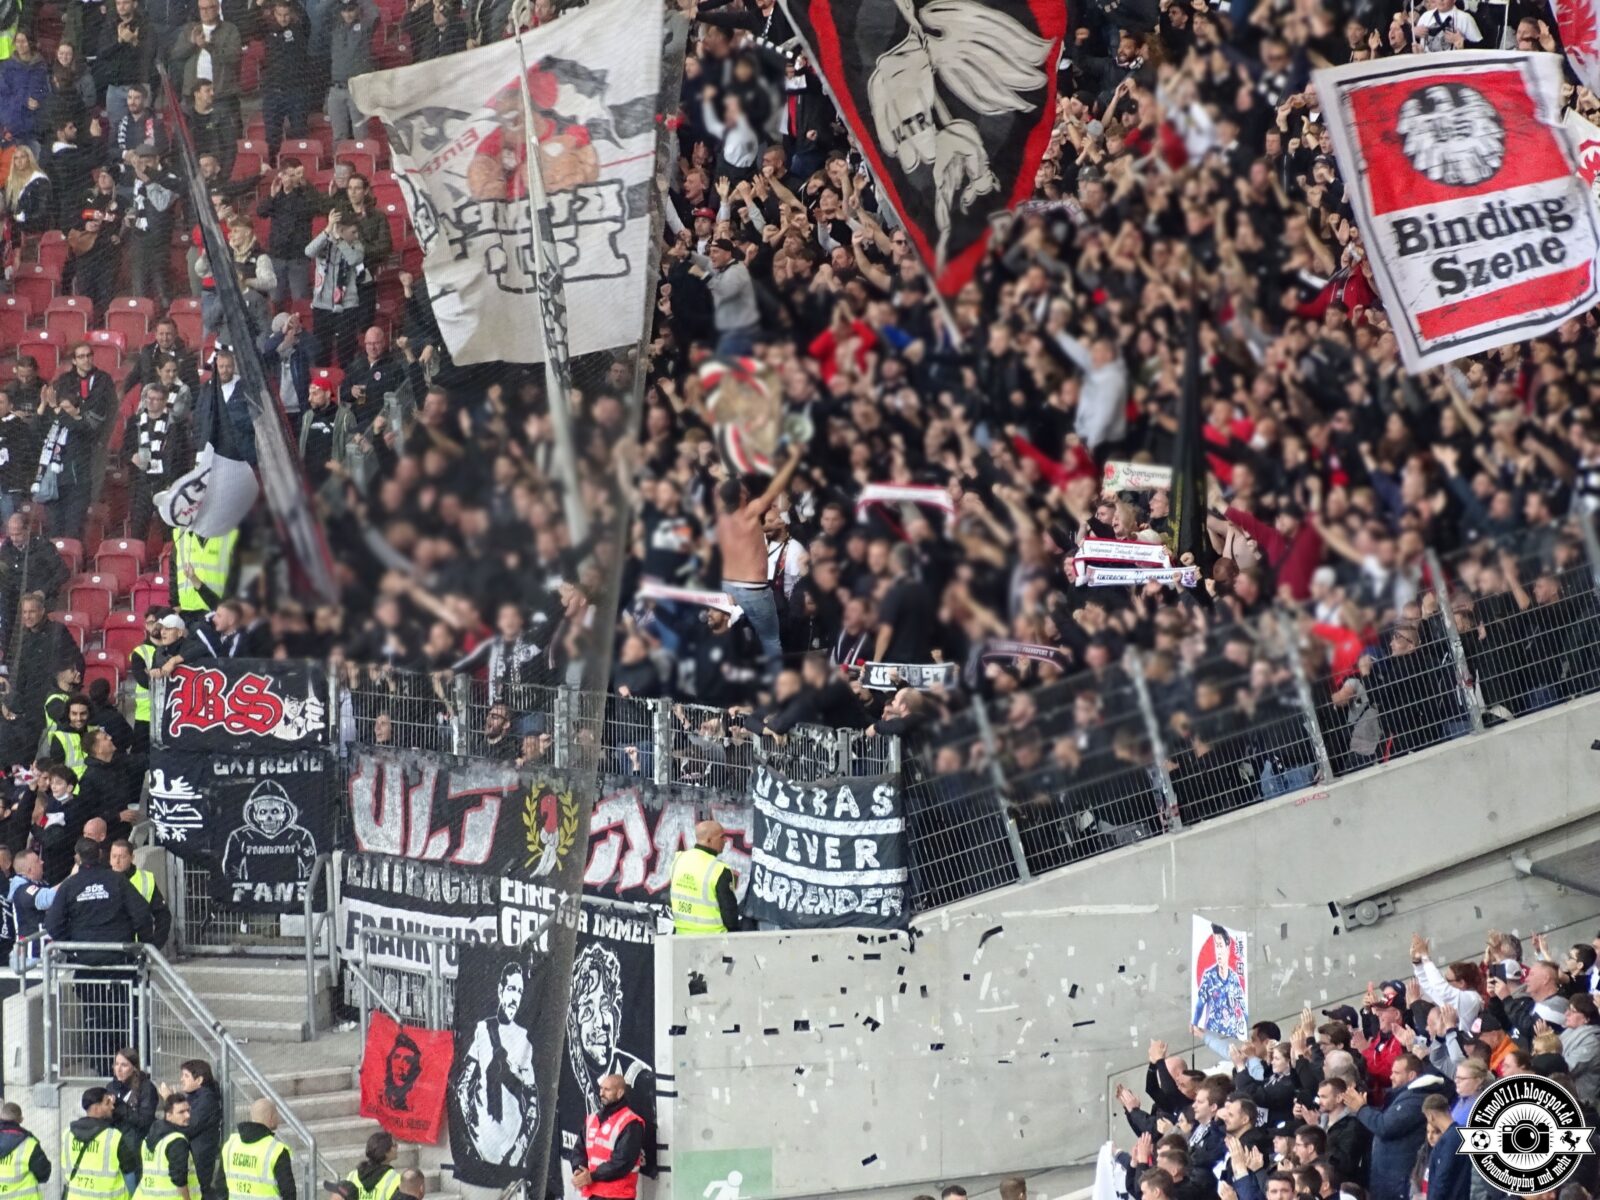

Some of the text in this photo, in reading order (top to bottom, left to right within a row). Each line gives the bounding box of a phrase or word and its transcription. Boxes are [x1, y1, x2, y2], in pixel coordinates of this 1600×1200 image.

[1391, 195, 1574, 257] Binding
[1431, 236, 1567, 298] Szene
[165, 664, 285, 738] BS
[755, 765, 895, 818] ULTRAS
[763, 818, 880, 869] NEVER
[752, 865, 904, 917] SURRENDER
[232, 1152, 258, 1169] SECURITY
